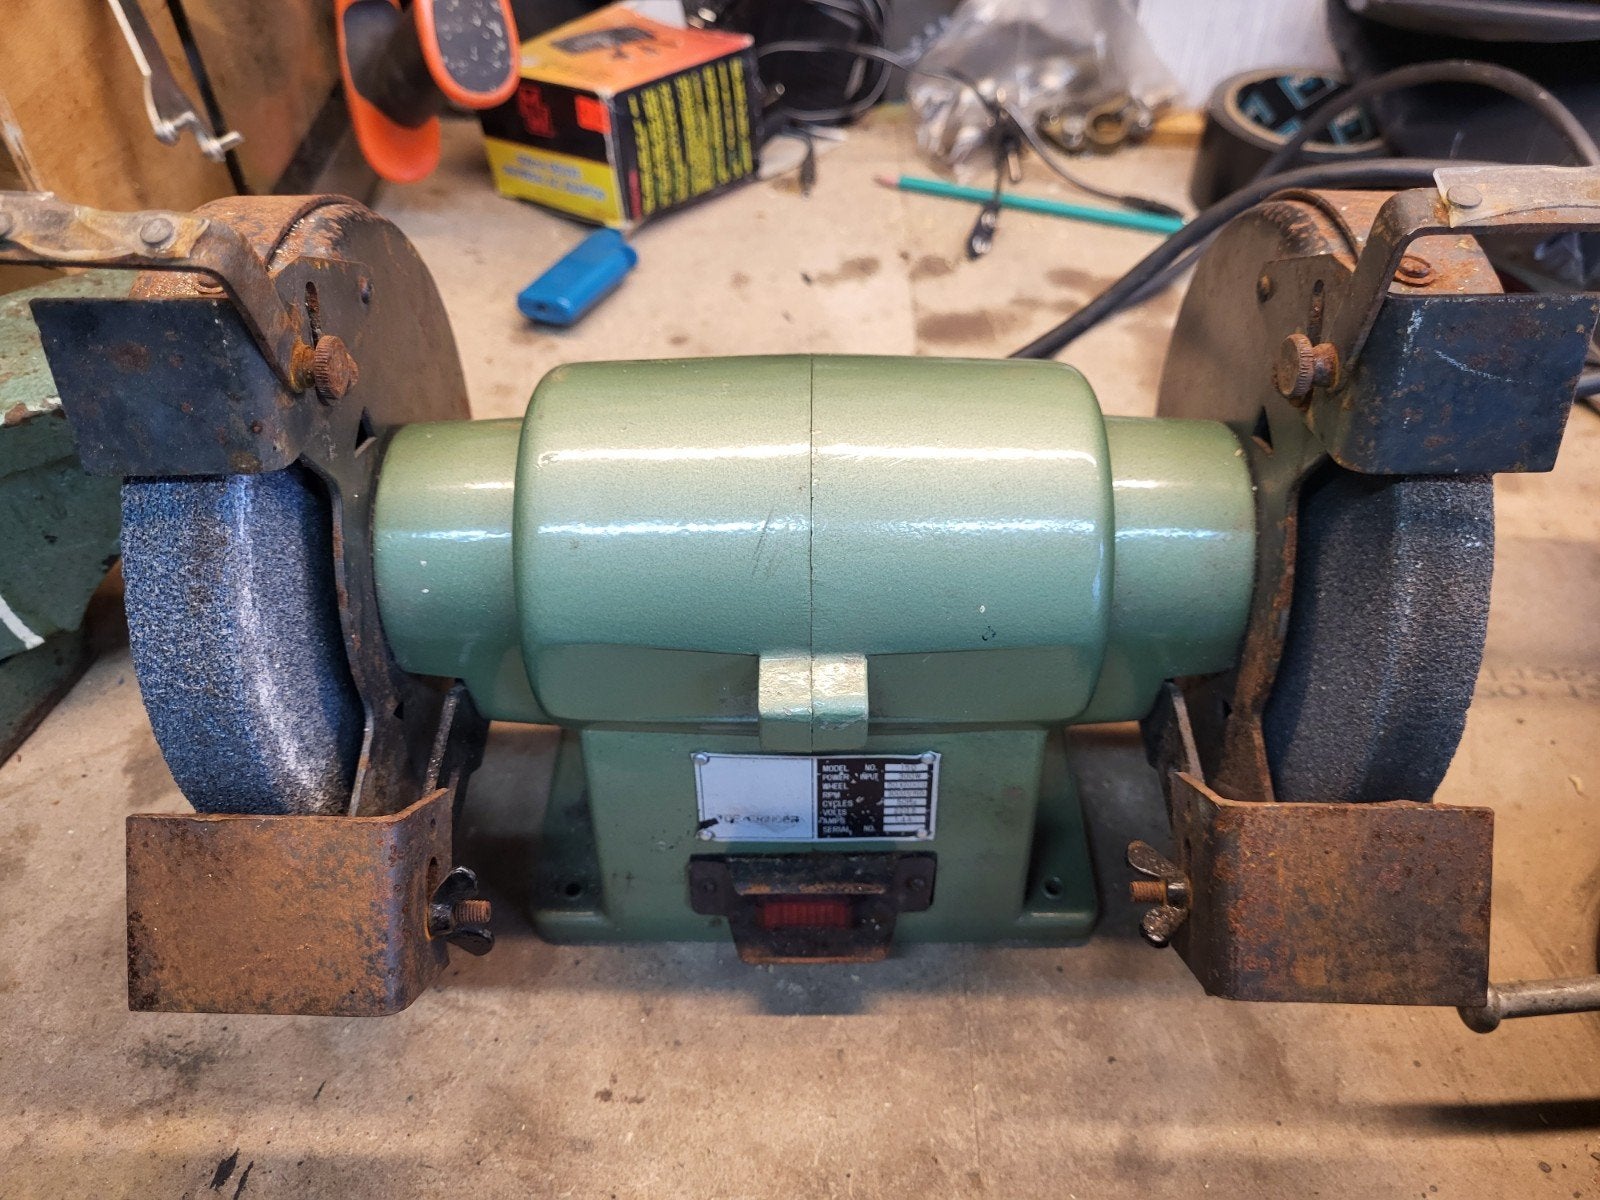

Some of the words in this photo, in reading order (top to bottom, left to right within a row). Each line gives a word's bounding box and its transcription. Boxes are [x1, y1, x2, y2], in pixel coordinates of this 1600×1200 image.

[822, 764, 849, 773] MODEL
[864, 763, 877, 772] NO.
[822, 773, 850, 781] POWER
[860, 773, 880, 781] INPUT
[822, 782, 849, 791] WHEEL
[822, 791, 841, 799] RPM
[822, 800, 854, 808] CYCLES
[822, 808, 848, 816] VOLTS
[822, 825, 850, 834] SERIAL
